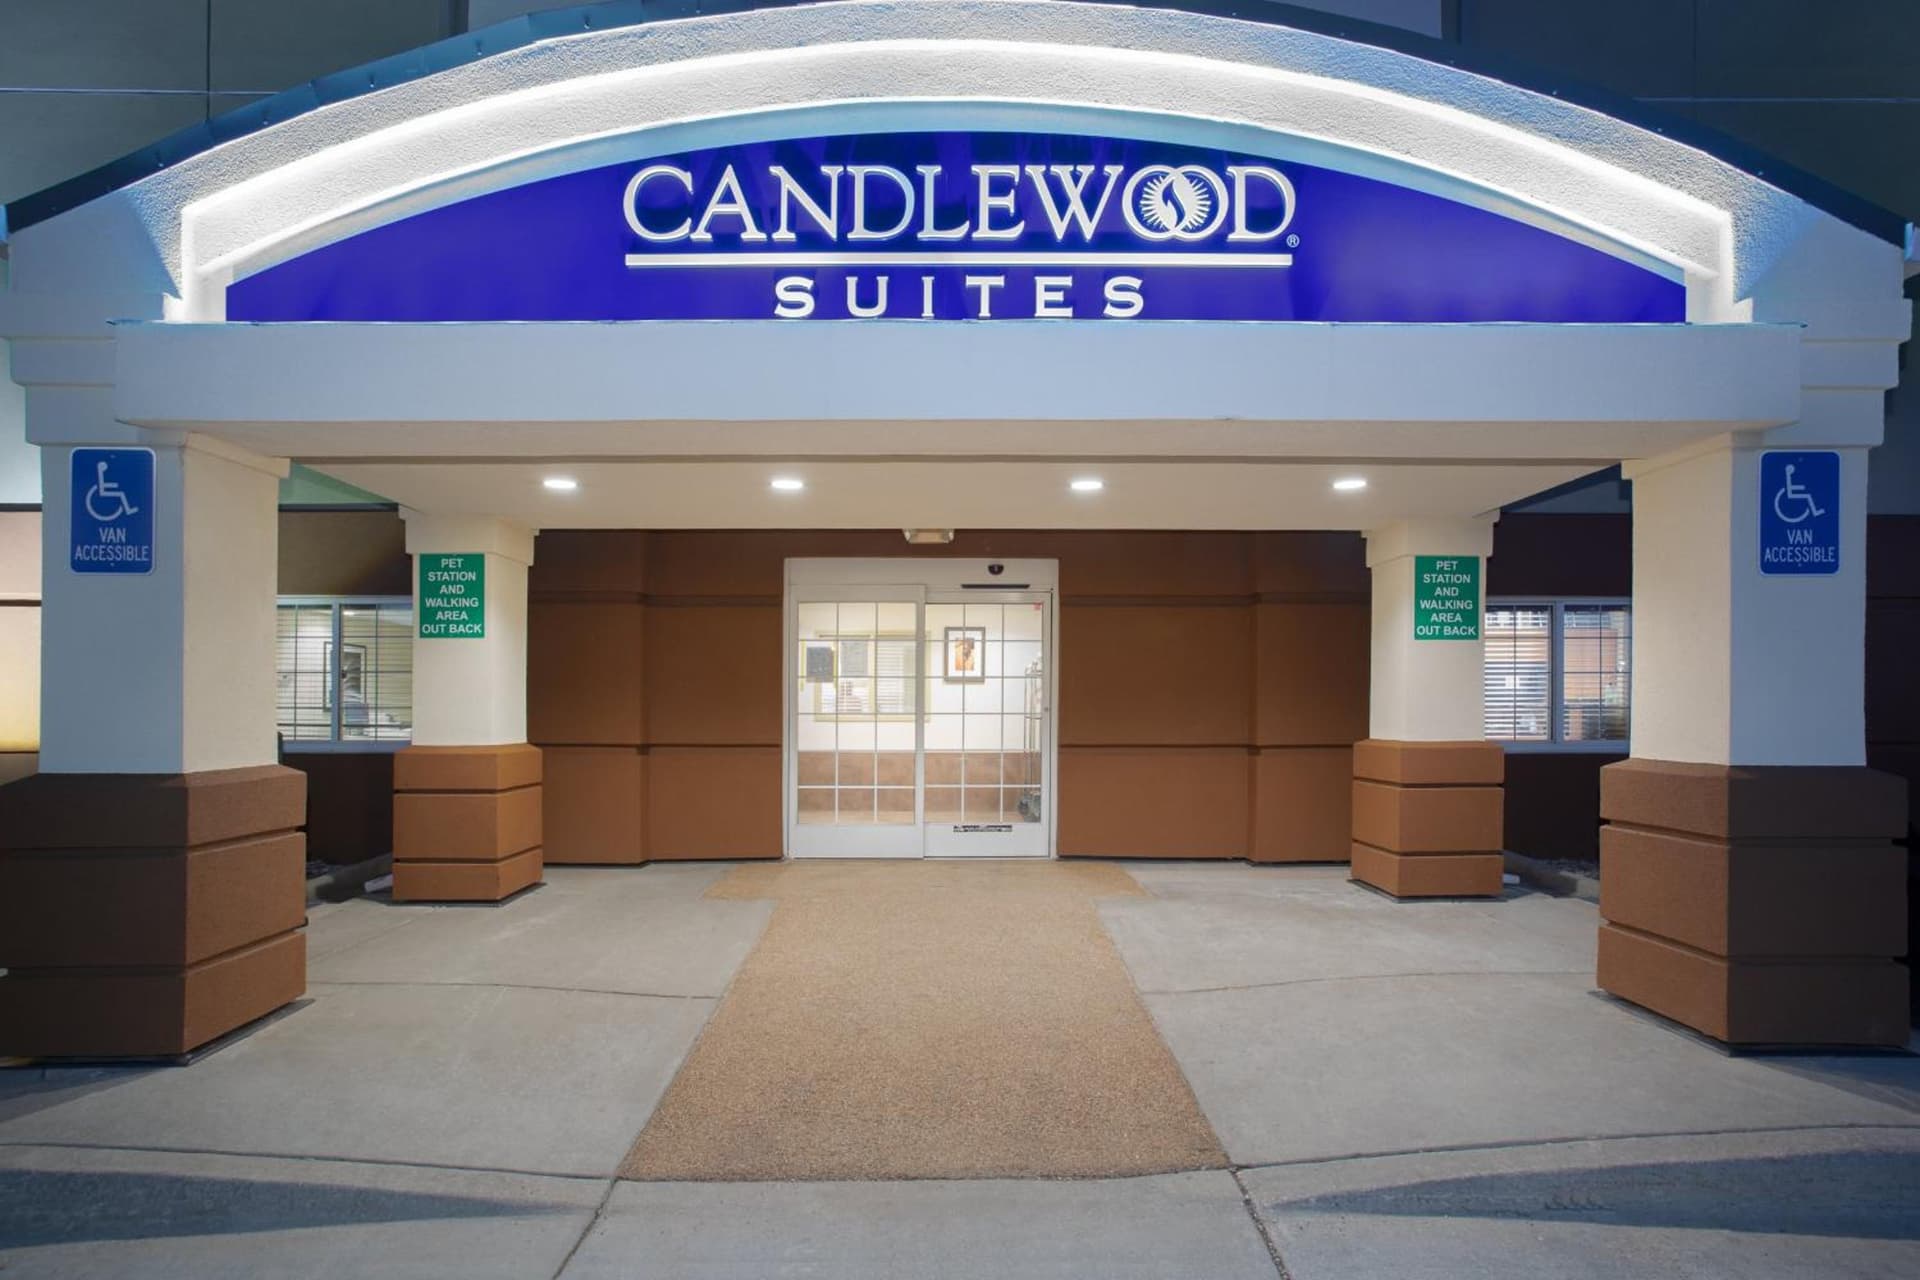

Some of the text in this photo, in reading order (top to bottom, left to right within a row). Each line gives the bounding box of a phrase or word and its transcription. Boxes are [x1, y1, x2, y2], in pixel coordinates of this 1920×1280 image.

[622, 163, 1297, 242] CANDLEWOOD
[773, 275, 1146, 319] SUITES
[99, 527, 127, 543] VAN
[1786, 529, 1813, 545] VAN
[74, 544, 150, 561] ACCESSIBLE
[1763, 546, 1836, 562] ACCESSIBLE
[441, 558, 464, 568] PET
[1435, 560, 1458, 571] PET
[427, 571, 477, 582] STATION
[1423, 573, 1471, 584] STATION
[440, 584, 465, 595] AND
[1434, 586, 1459, 597] AND
[425, 597, 479, 608] WALKING
[1420, 599, 1473, 610] WALKING
[435, 610, 469, 621] AREA
[1430, 612, 1463, 623] AREA
[422, 623, 482, 634] OUT BACK
[1416, 625, 1477, 636] OUT BACK
